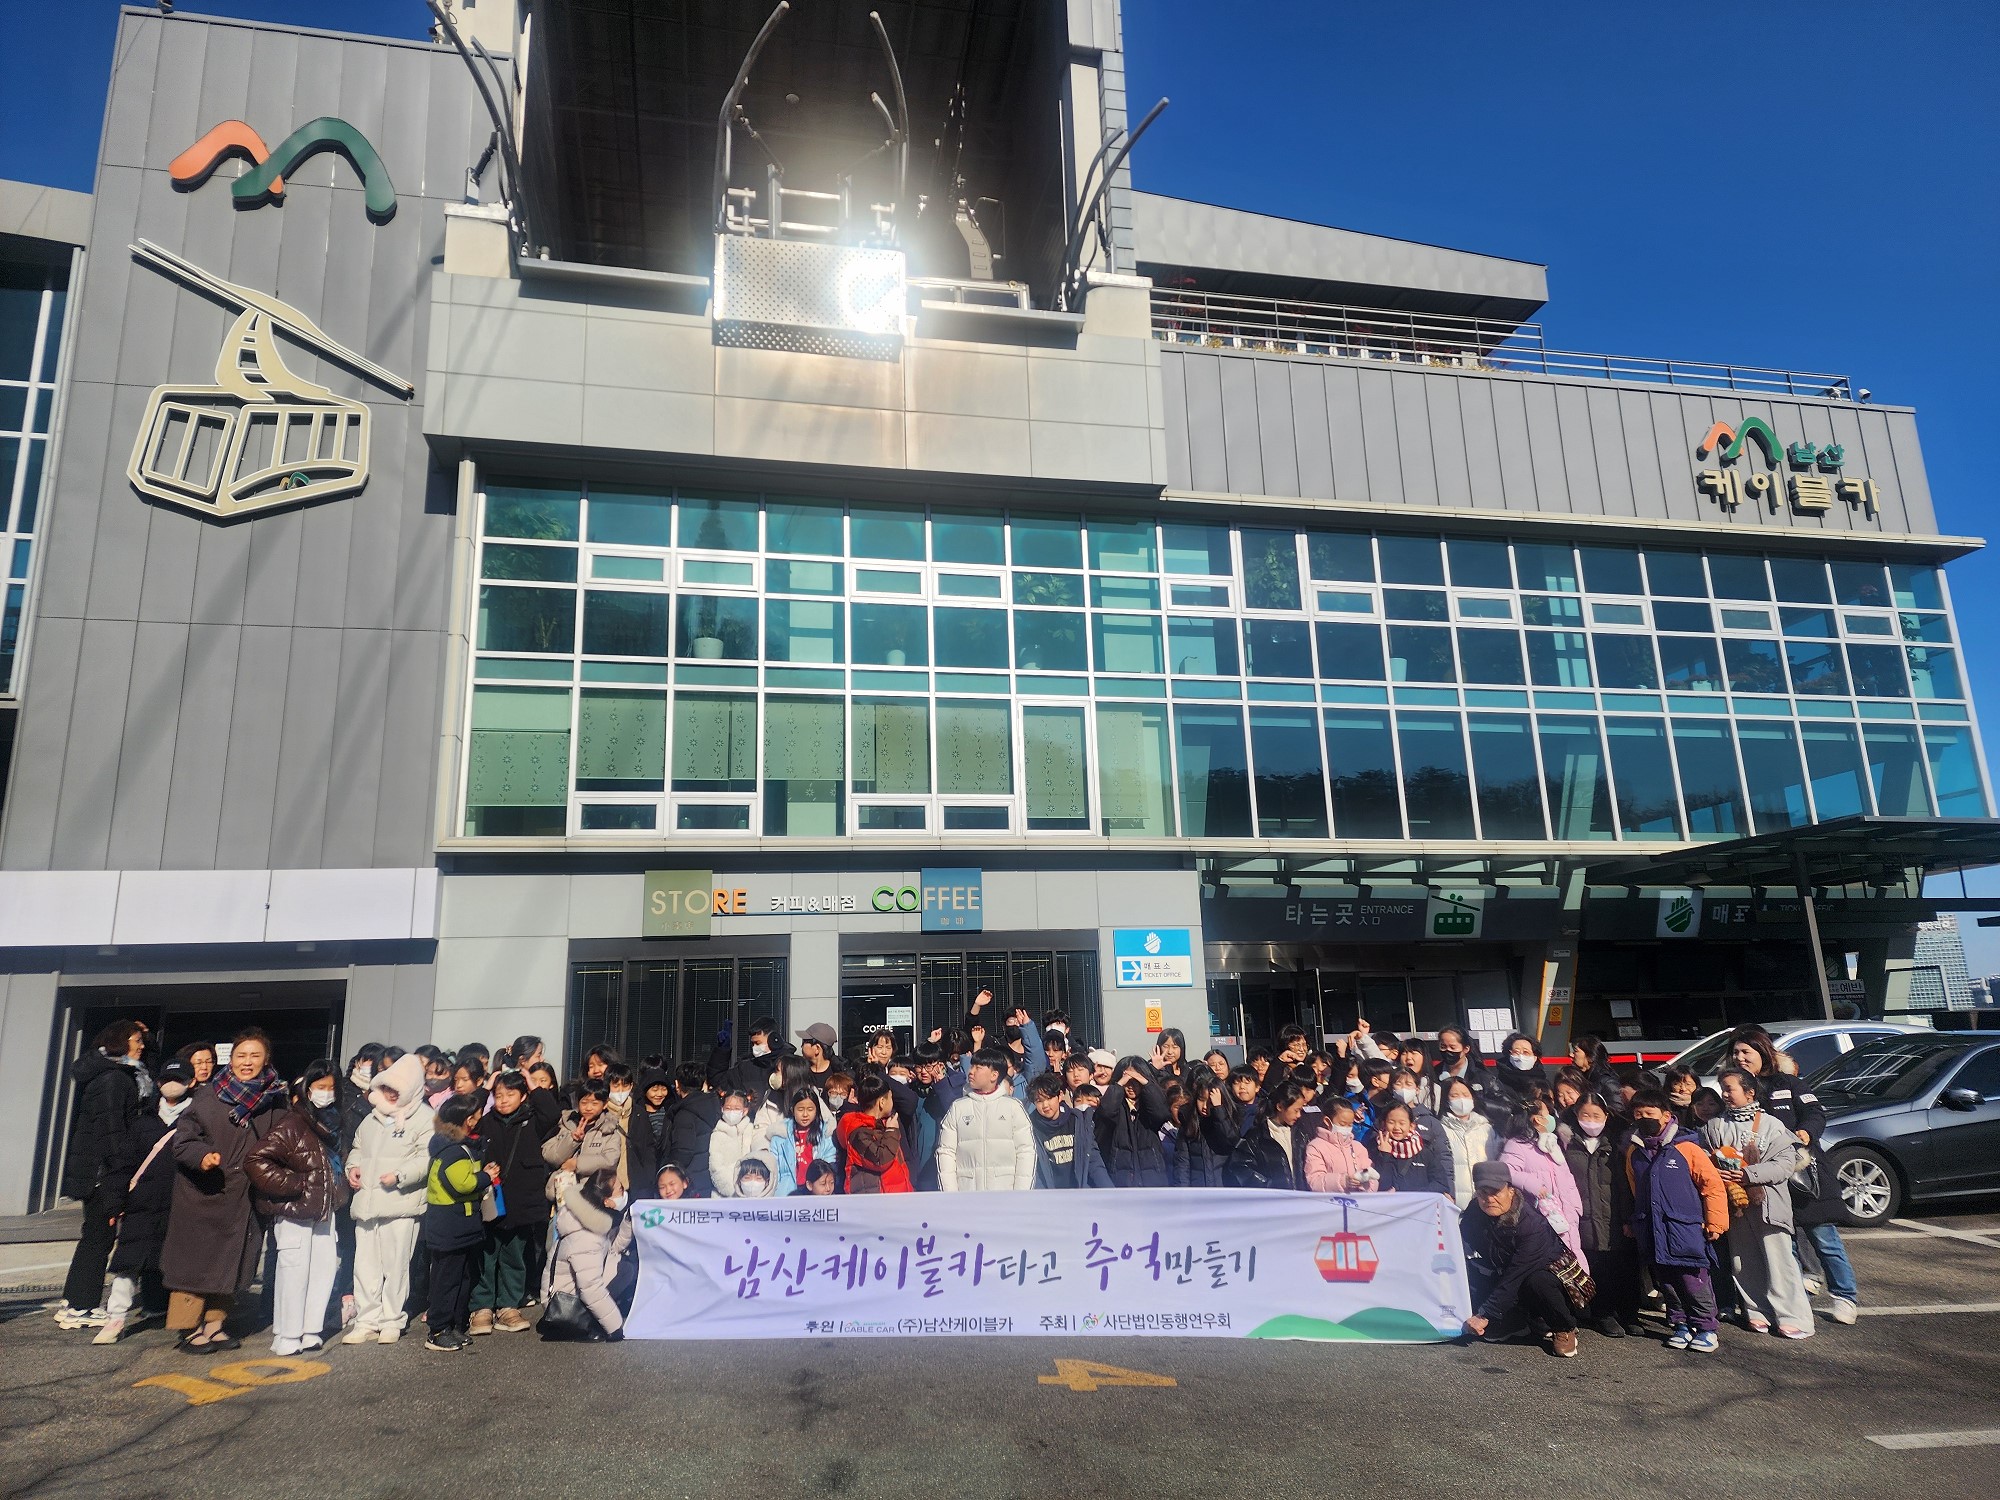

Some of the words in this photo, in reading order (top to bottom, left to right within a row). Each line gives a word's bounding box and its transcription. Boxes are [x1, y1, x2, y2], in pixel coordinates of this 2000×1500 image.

[1788, 441, 1845, 467] 남산
[1699, 469, 1881, 514] 케이블카
[651, 888, 748, 915] STORE
[771, 895, 857, 912] 커피&매점
[872, 885, 980, 911] COFFEE
[1360, 905, 1414, 914] ENTRANCE
[1359, 916, 1380, 925] 入口
[1143, 962, 1171, 970] 매표소
[668, 1211, 725, 1224] 서대문구
[728, 1208, 840, 1223] 우리동네키움센터
[1084, 1222, 1257, 1292] 추억만들기
[803, 1320, 835, 1334] 후원
[844, 1326, 874, 1334] CABLE
[876, 1326, 895, 1334] CAR
[897, 1316, 1014, 1334] (주)남산케이블카
[1039, 1314, 1068, 1332] 주최
[1103, 1312, 1232, 1331] 사단법인동행연우회
